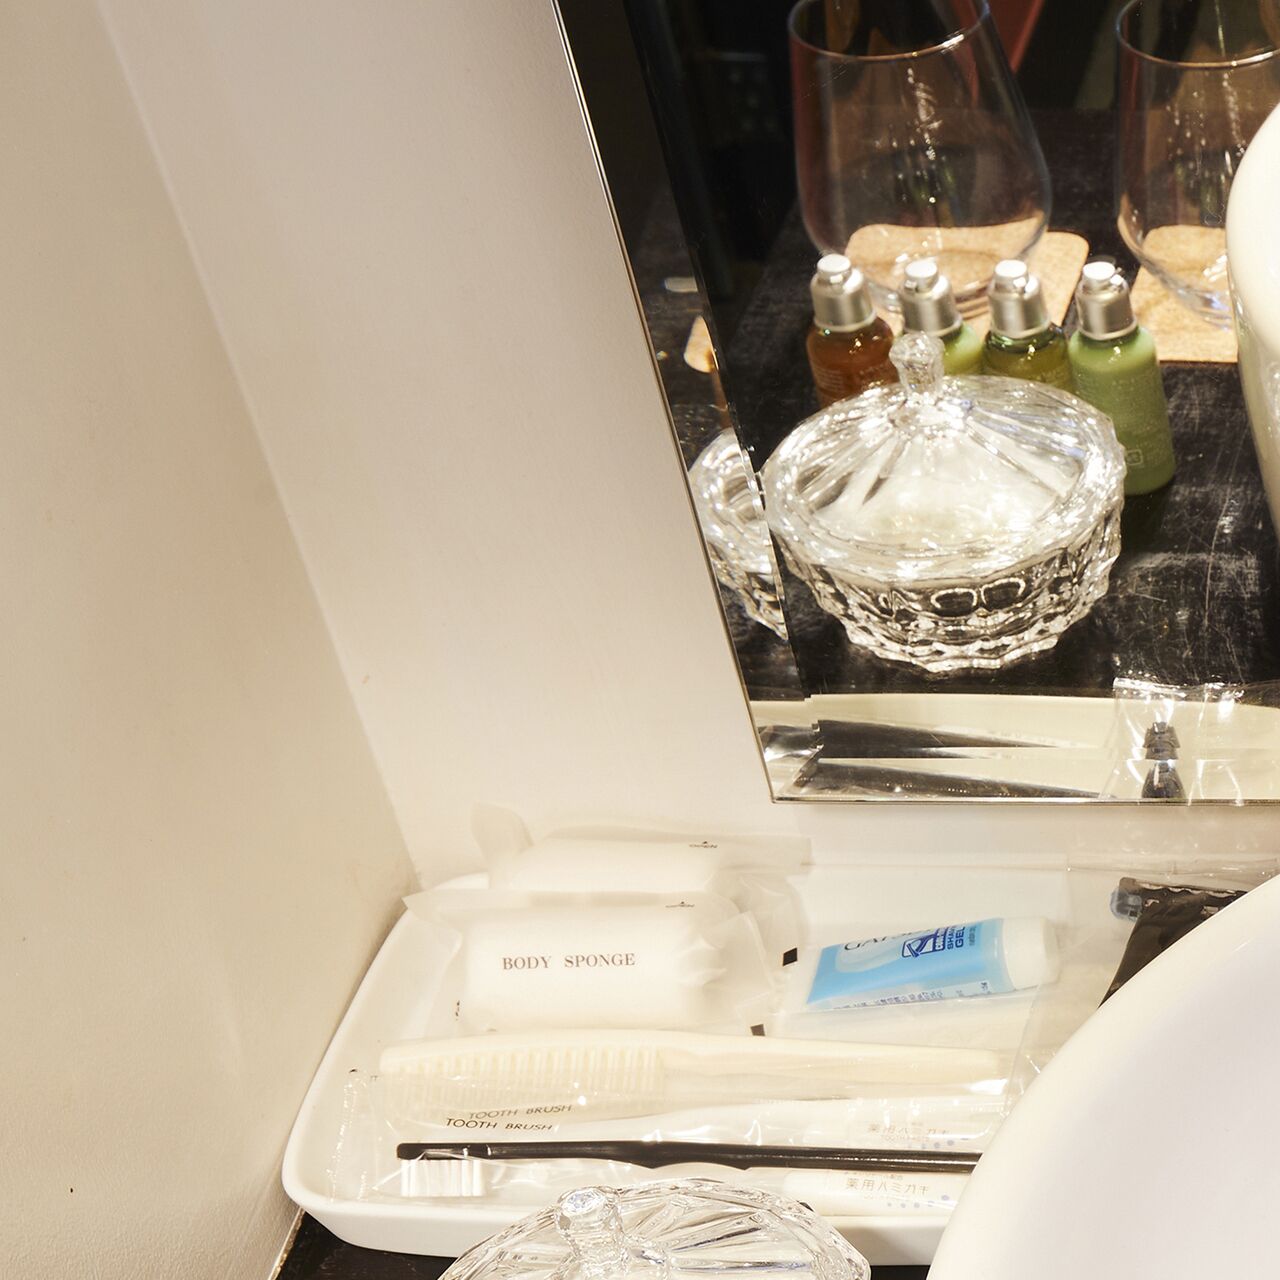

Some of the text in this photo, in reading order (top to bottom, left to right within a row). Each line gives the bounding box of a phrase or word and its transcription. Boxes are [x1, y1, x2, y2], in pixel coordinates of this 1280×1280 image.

[955, 926, 965, 948] GEL
[502, 953, 636, 971] BODY SPONGE
[469, 1104, 572, 1119] TOOTH BRUSH
[446, 1118, 553, 1131] TOOTH BRUSH
